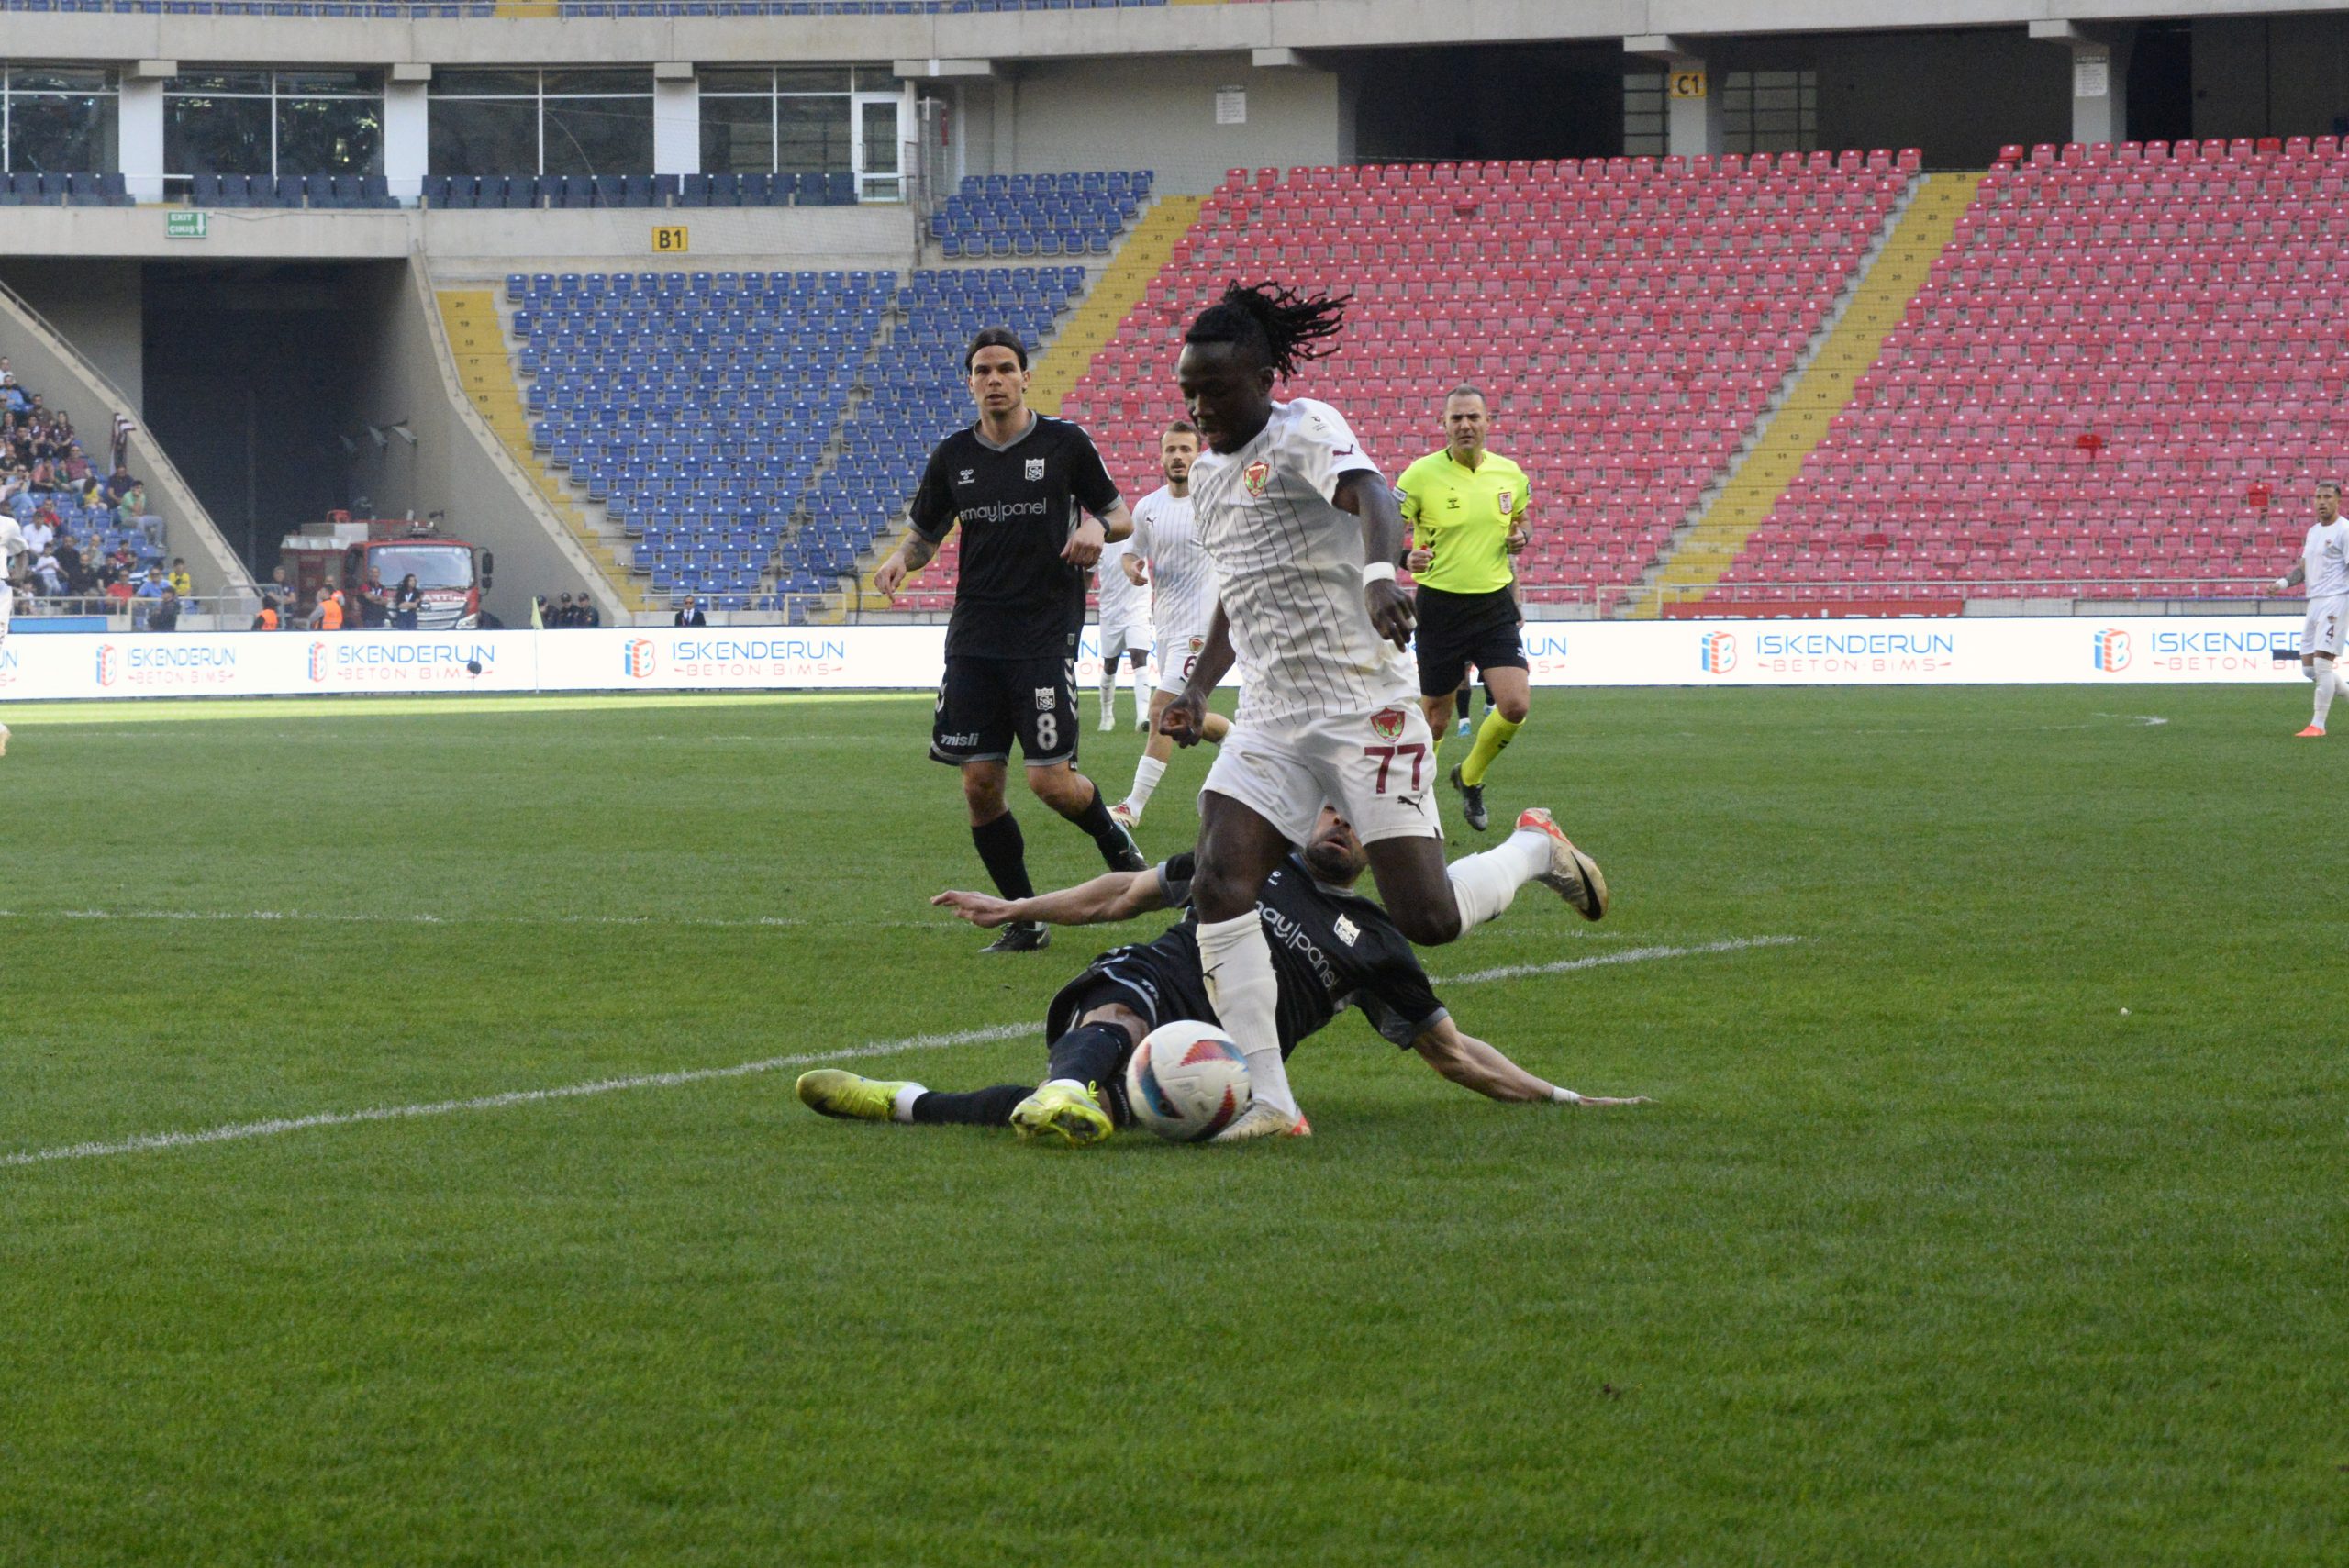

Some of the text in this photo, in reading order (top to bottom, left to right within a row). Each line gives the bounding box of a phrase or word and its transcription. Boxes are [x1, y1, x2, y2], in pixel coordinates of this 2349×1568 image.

[1678, 75, 1699, 95] C1
[171, 213, 193, 221] EXIT
[659, 229, 682, 249] B1
[2326, 625, 2334, 639] 4
[1183, 655, 1197, 678] 6
[941, 732, 980, 747] misli
[1037, 712, 1059, 751] 8
[1364, 743, 1427, 795] 77
